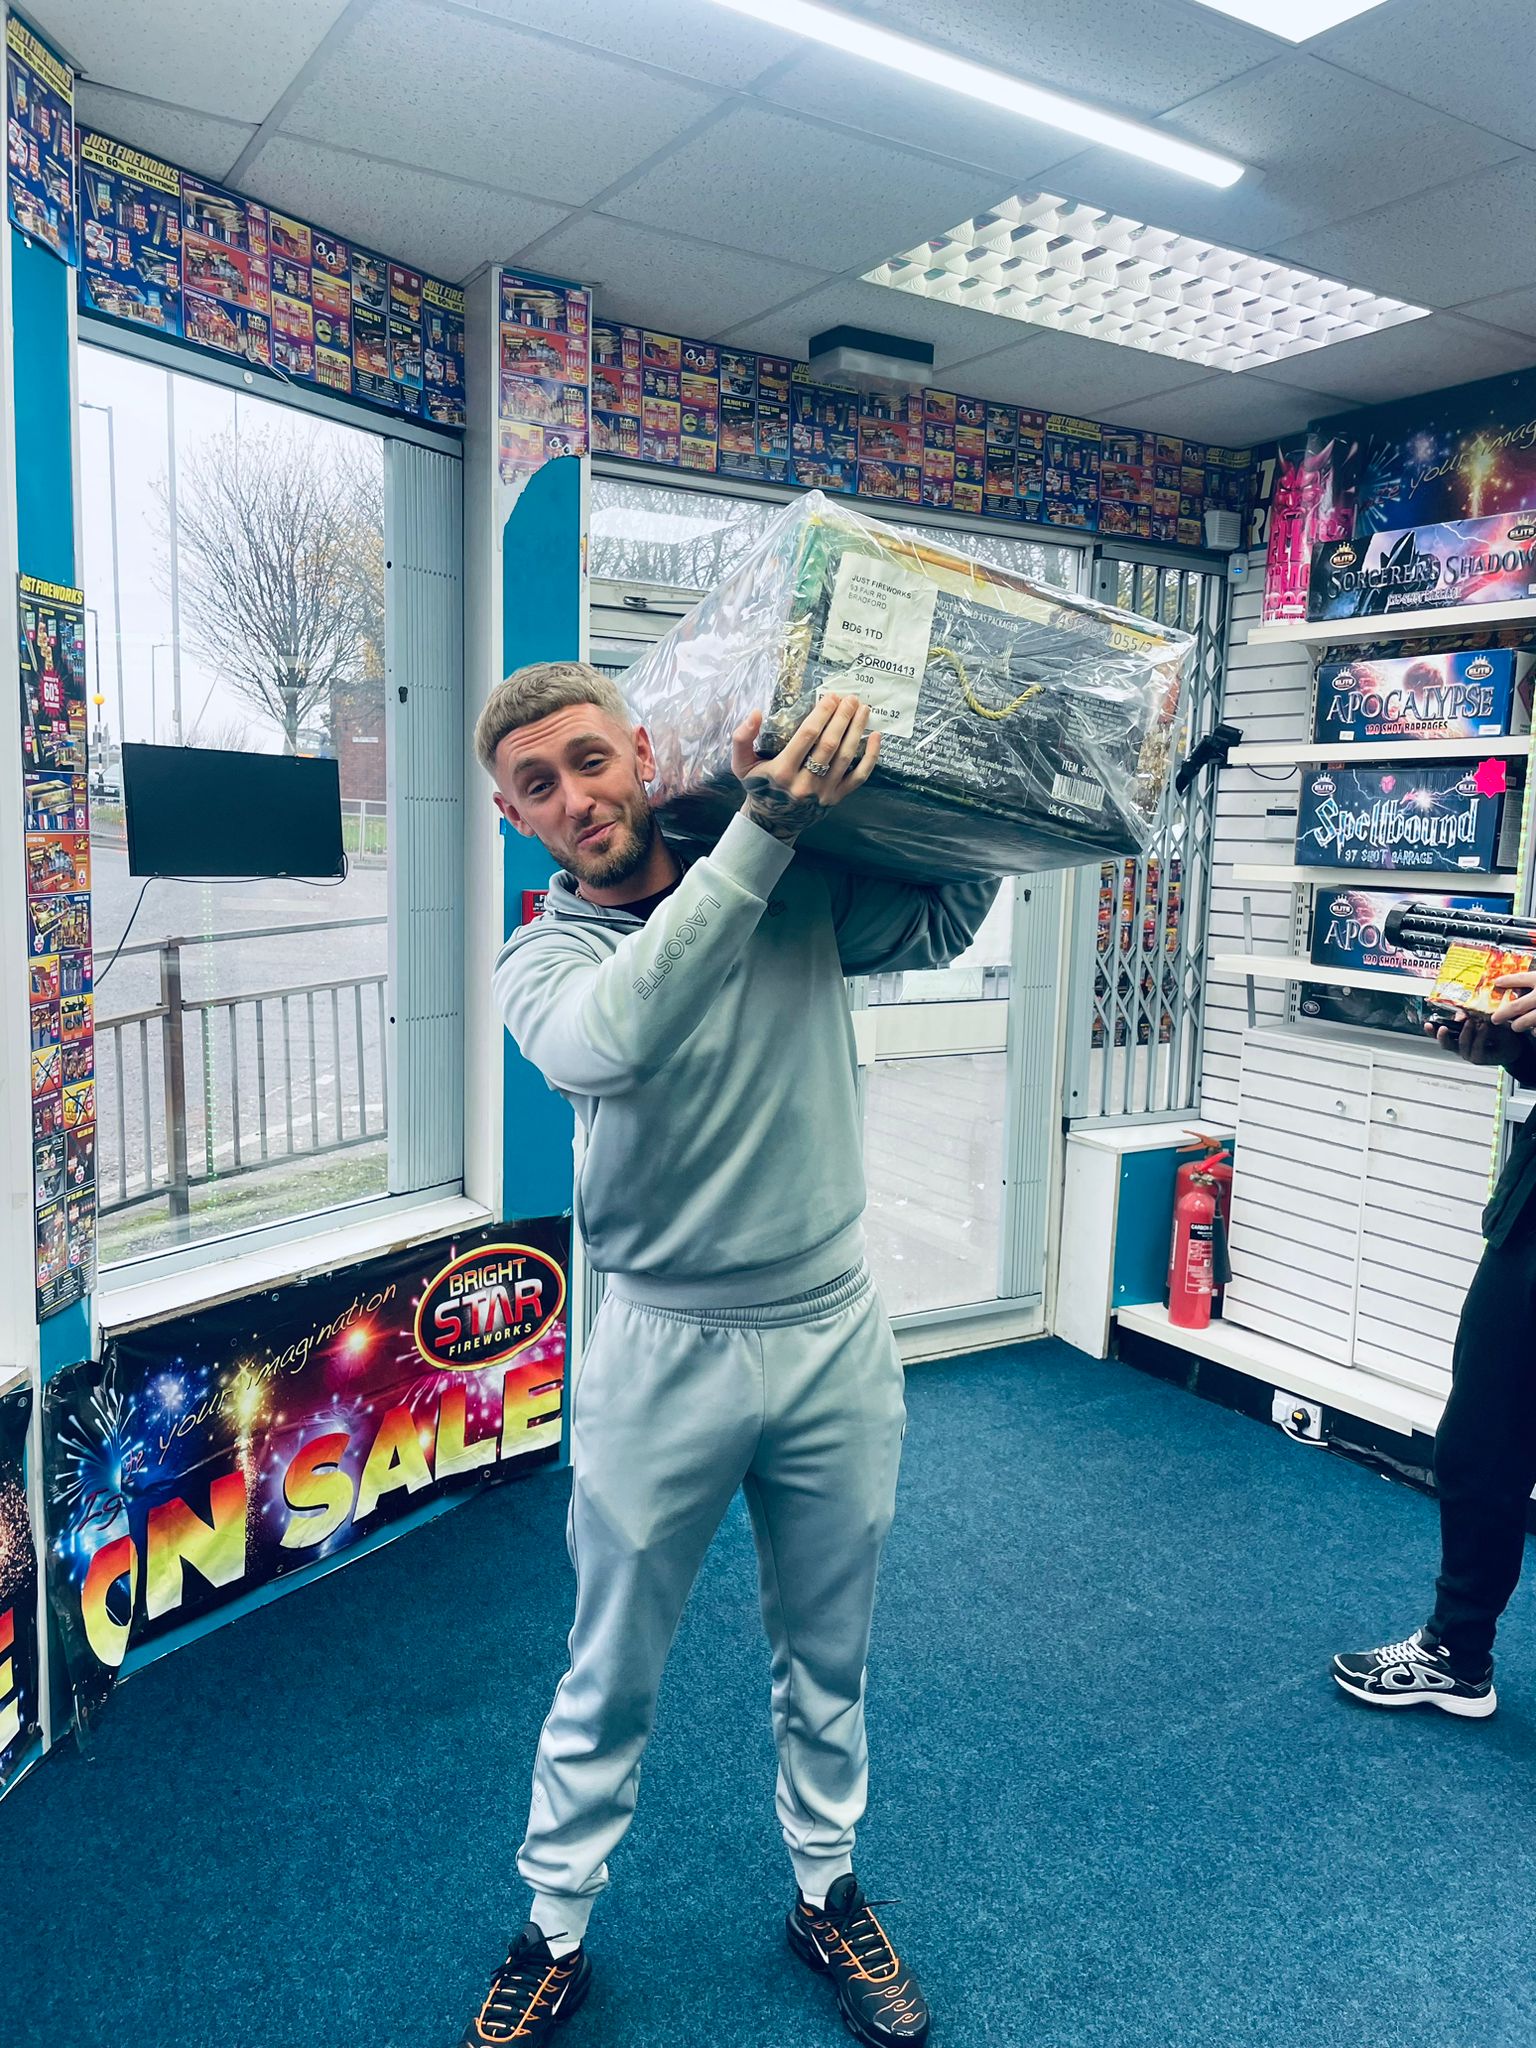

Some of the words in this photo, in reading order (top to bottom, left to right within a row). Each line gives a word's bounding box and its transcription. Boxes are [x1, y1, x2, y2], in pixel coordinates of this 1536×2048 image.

[84, 133, 117, 156] JUST
[116, 145, 180, 181] FIREWORKS
[424, 279, 445, 297] JUST
[1332, 553, 1355, 564] ELITE
[851, 574, 871, 586] JUST
[871, 580, 912, 599] FIREWORKS
[1329, 560, 1441, 598] SORCERER'S
[35, 580, 83, 604] FIREWORKS
[848, 592, 887, 610] BRADFORD
[876, 591, 887, 601] RD
[842, 620, 862, 634] BD6
[864, 626, 883, 640] 1TD
[856, 655, 915, 676] SOR001413
[1468, 666, 1490, 676] ELITE
[855, 672, 875, 684] 3030
[1334, 677, 1355, 687] ELITE
[890, 707, 901, 719] 32
[1327, 687, 1495, 723] APOCALYPSE
[1365, 724, 1380, 734] 120
[1381, 723, 1401, 734] SHOT
[1403, 720, 1448, 733] BARRAGES
[1062, 760, 1079, 774] ITEM
[1315, 782, 1335, 792] ELITE
[1314, 797, 1480, 859] Spellbound
[1344, 850, 1358, 862] 97
[1361, 849, 1388, 864] SHOT
[1391, 852, 1434, 866] BARRAGE
[1331, 904, 1351, 914] ELITE
[632, 894, 721, 1000] LACOSTE
[1362, 955, 1378, 965] 120
[1379, 956, 1399, 967] SHOT
[449, 1257, 527, 1298] BRIGHT
[435, 1278, 543, 1348] STAR
[449, 1322, 532, 1357] FIREWORKS
[158, 1388, 233, 1465] your
[247, 1283, 397, 1389] imagination
[280, 1359, 563, 1549] SALE
